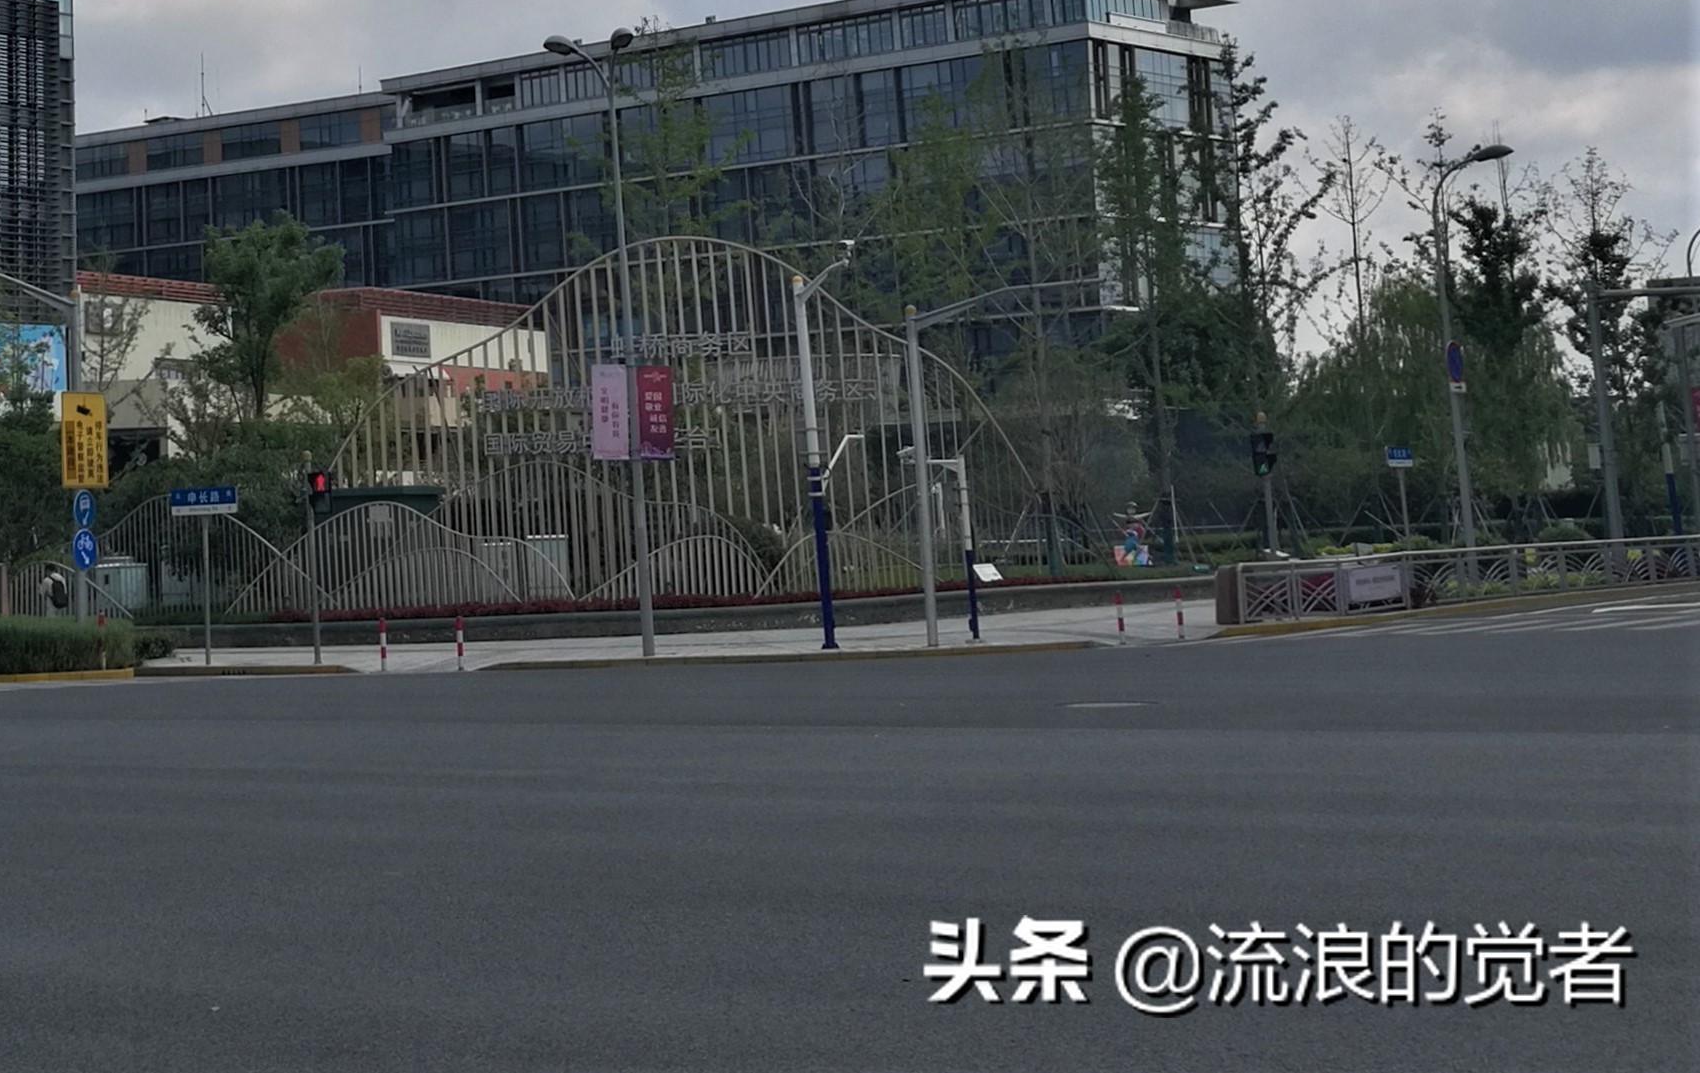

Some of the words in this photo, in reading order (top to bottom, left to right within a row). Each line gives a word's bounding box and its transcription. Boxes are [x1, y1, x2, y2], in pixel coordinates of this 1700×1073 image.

[610, 330, 753, 359] 虹桥商务区
